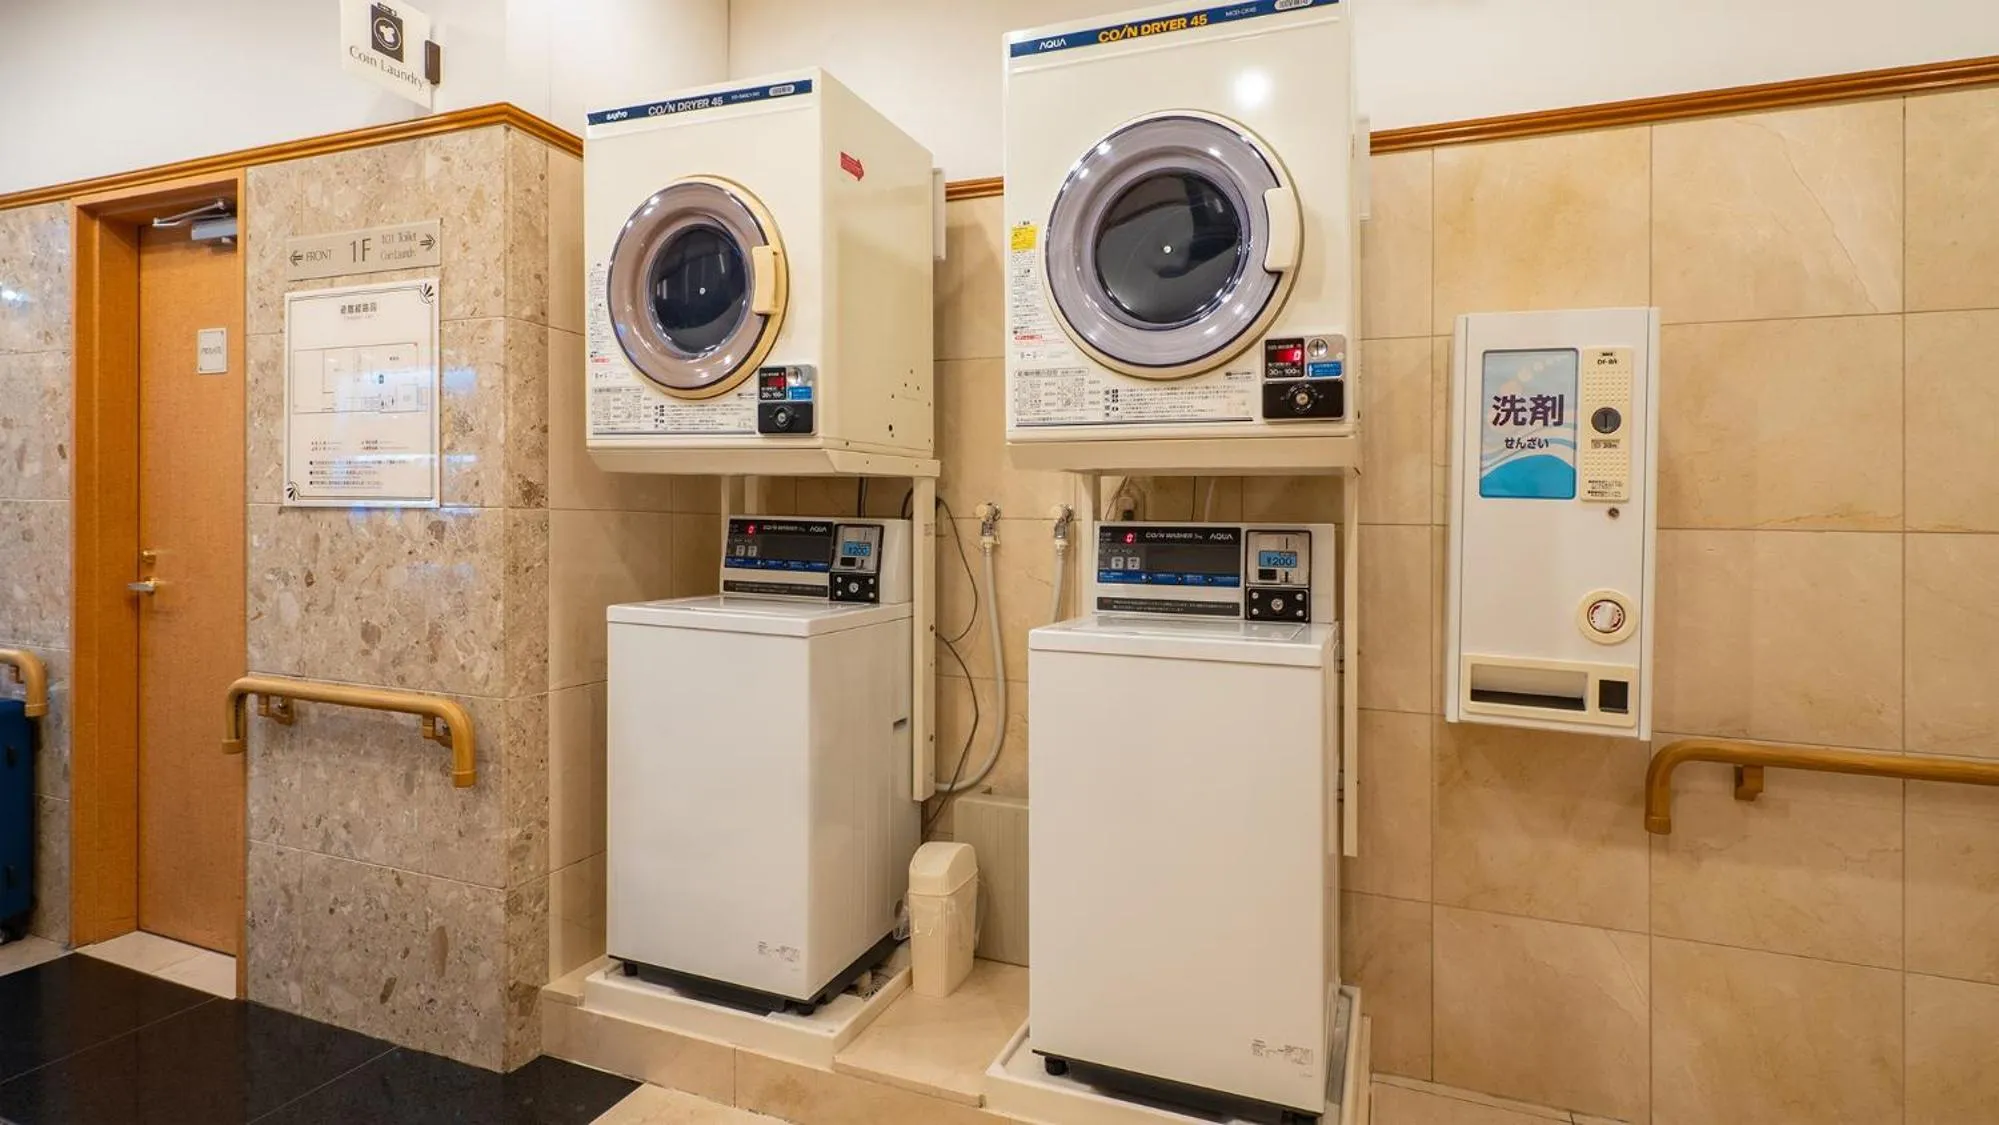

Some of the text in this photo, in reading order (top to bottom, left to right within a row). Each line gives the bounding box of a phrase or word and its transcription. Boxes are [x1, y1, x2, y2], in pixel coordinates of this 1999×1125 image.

[1098, 13, 1208, 44] COIN DRYER 45
[1038, 37, 1067, 51] AQUA
[349, 45, 424, 90] Coin Laundry
[647, 102, 676, 117] COIN
[677, 97, 710, 112] DRYER
[711, 96, 724, 107] 45
[306, 249, 332, 263] FRONT
[350, 238, 372, 263] 1F
[1491, 393, 1565, 427] 洗剤
[1504, 437, 1550, 449] せんざい
[810, 525, 828, 533] AQUA
[1209, 532, 1234, 541] AQUA
